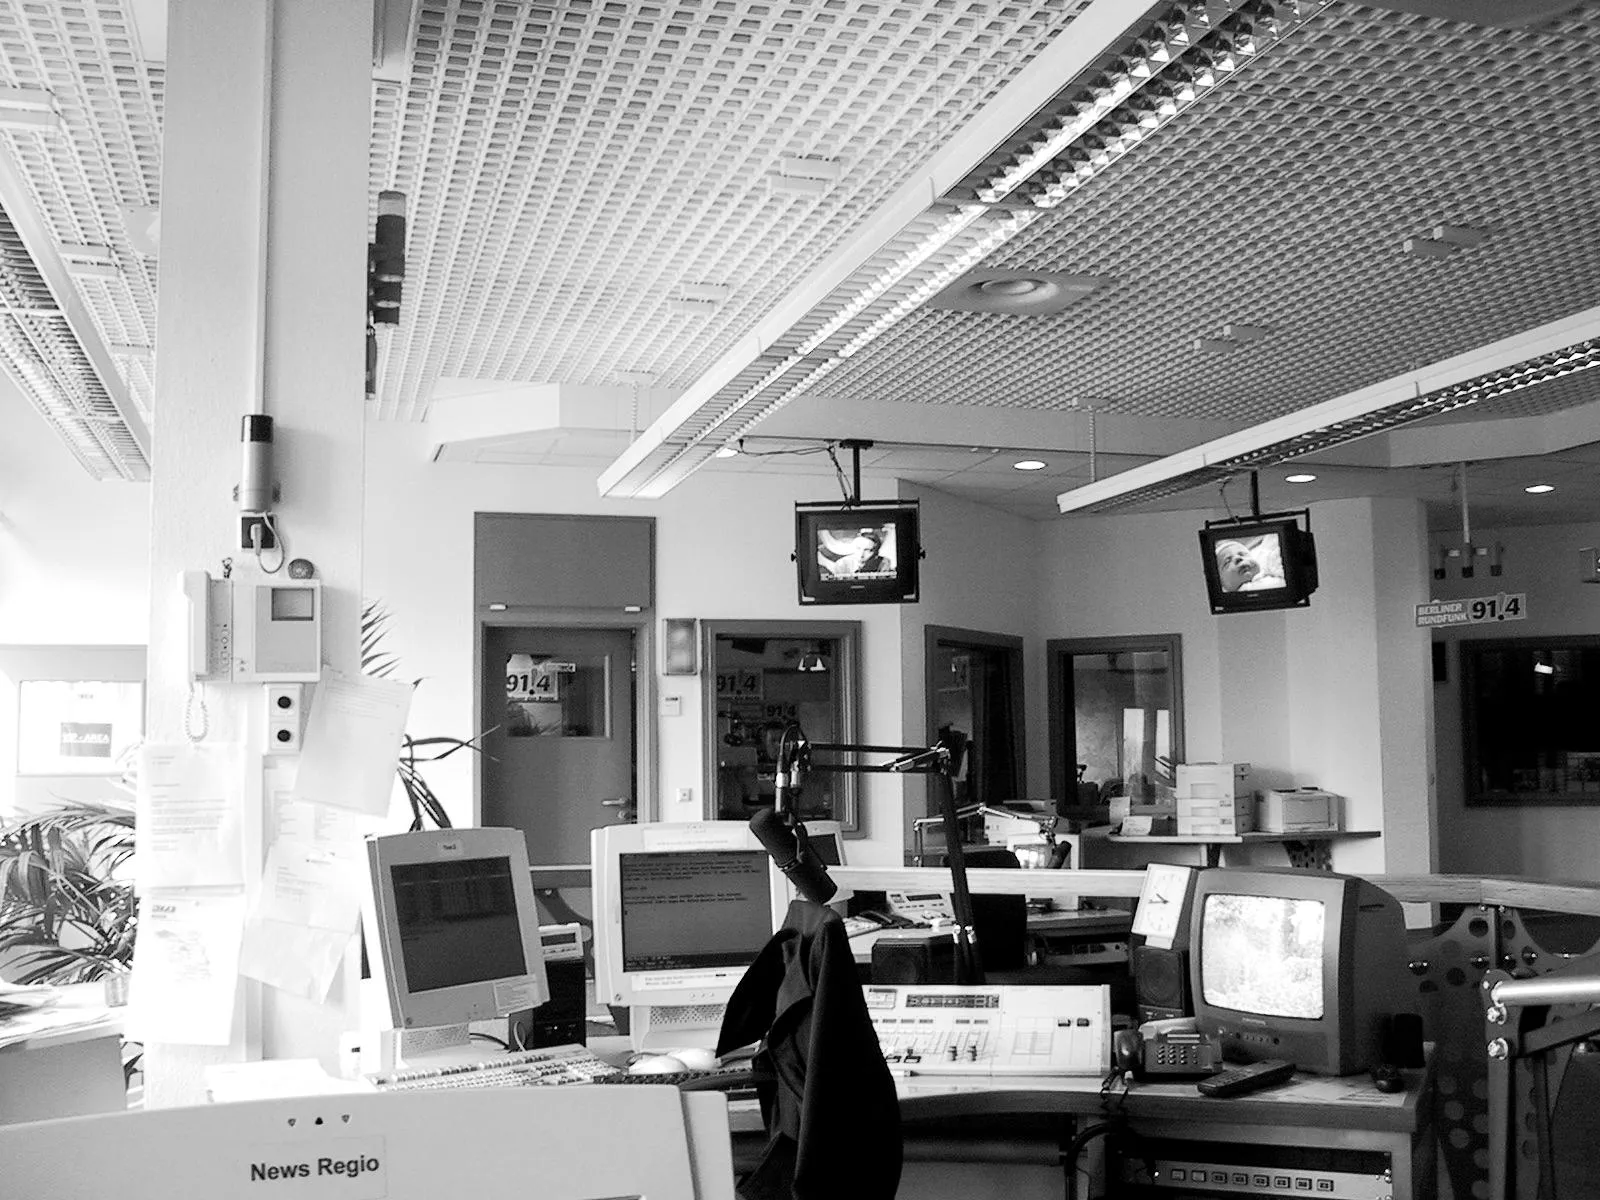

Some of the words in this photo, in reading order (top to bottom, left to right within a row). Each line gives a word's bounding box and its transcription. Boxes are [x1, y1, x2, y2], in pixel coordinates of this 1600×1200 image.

[1418, 603, 1462, 615] BERLINER
[1417, 613, 1467, 625] RUNDFUNK
[506, 674, 550, 695] 91.4
[250, 1161, 310, 1181] News
[318, 1155, 379, 1178] Regio
